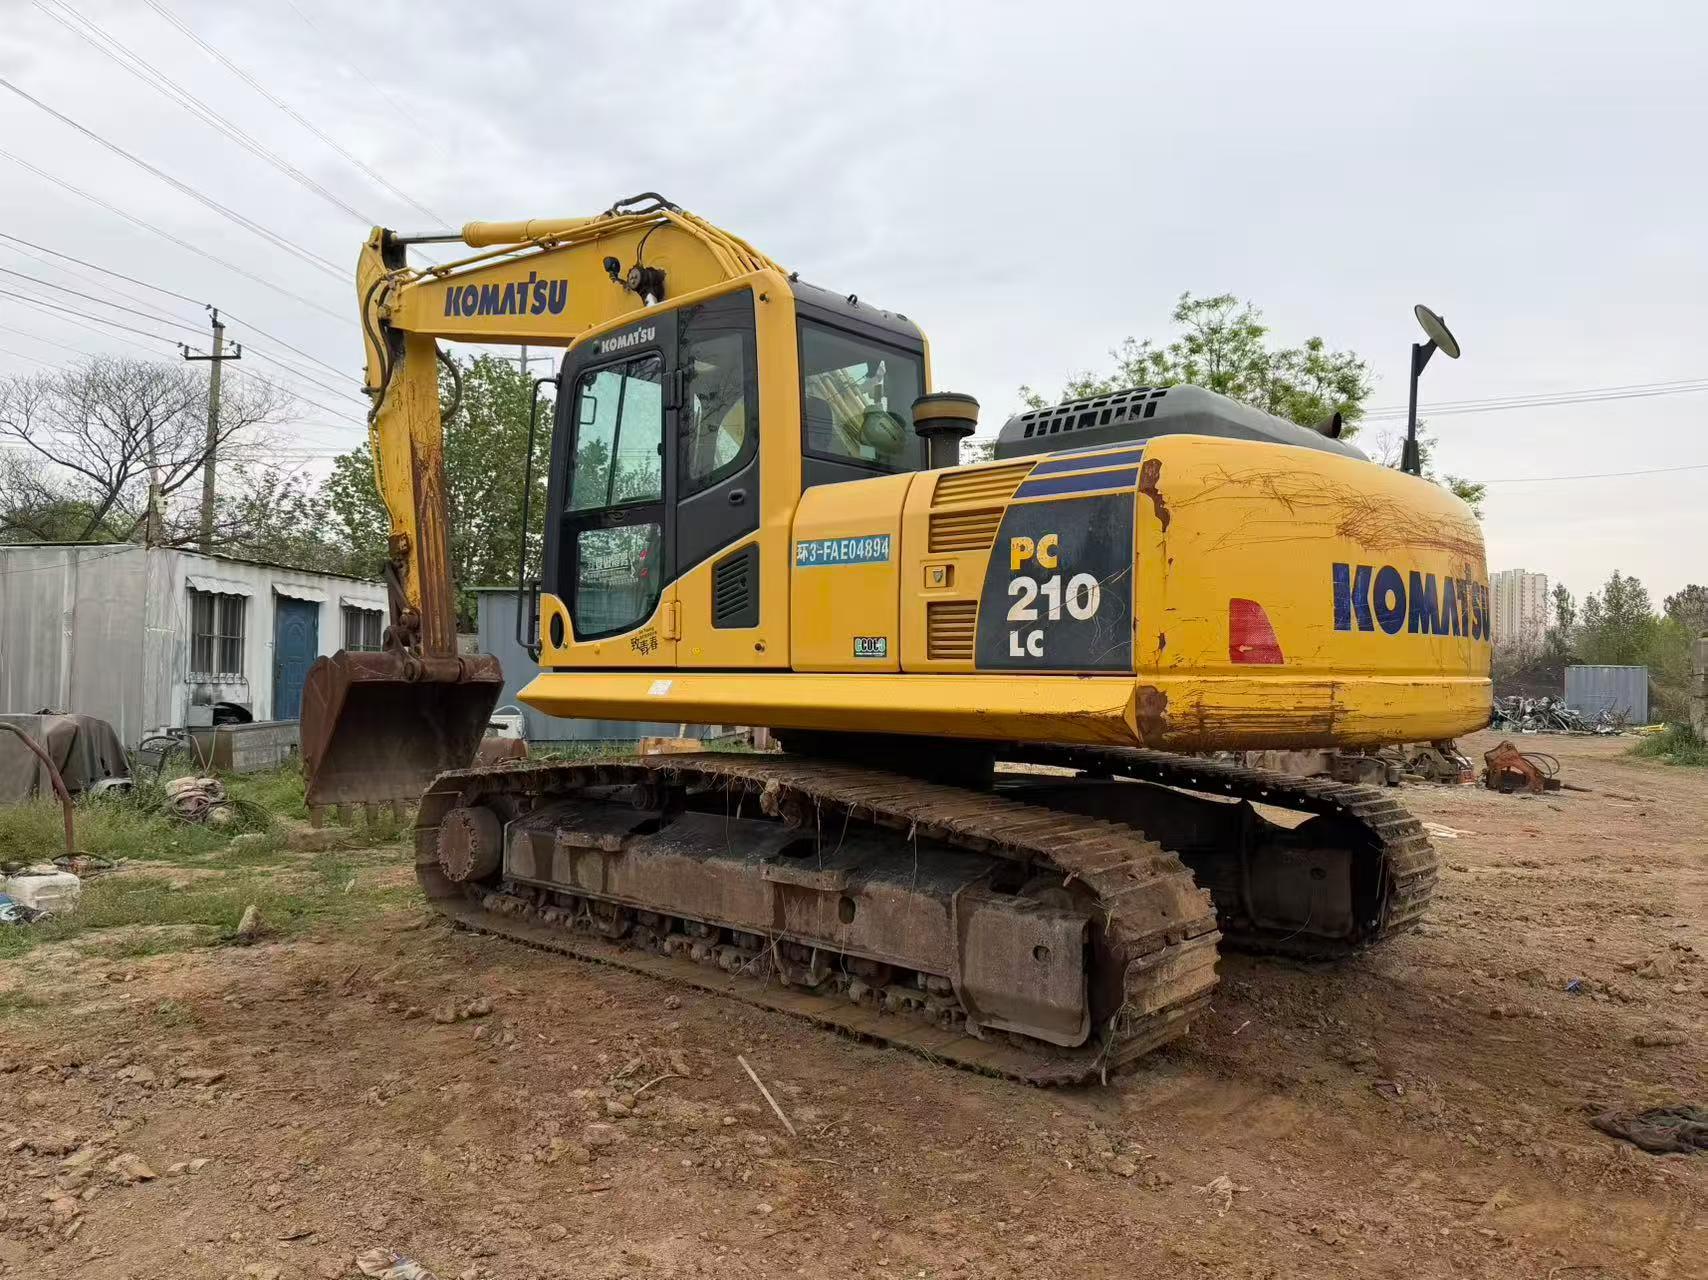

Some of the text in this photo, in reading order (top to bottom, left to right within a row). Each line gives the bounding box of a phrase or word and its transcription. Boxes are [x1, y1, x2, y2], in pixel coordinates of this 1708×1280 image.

[444, 271, 568, 317] KOMATSU
[601, 326, 656, 354] KOMATSU
[1010, 533, 1059, 570] PC
[1006, 573, 1101, 621] 210
[1331, 562, 1491, 642] KOMATSU
[1009, 630, 1044, 657] LC
